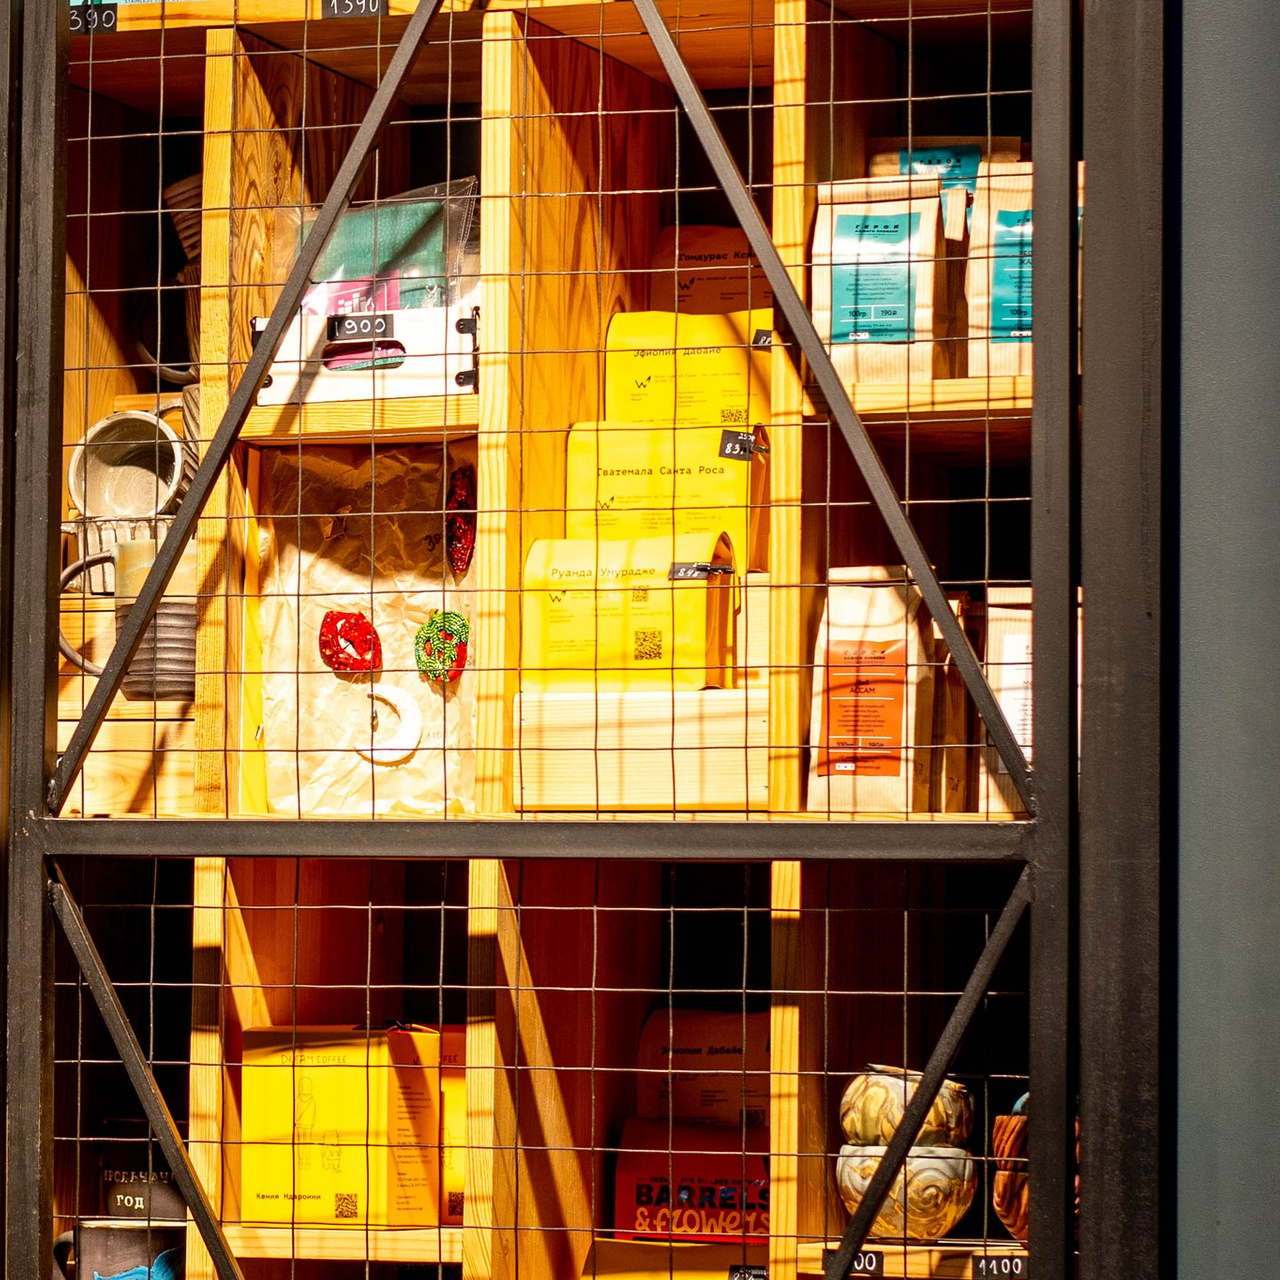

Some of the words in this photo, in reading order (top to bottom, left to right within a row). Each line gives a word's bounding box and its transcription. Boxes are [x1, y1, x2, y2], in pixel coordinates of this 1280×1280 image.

[335, 317, 387, 337] 1900
[597, 467, 653, 477] Гватемала
[699, 465, 725, 475] Роса
[551, 568, 593, 580] Руанда
[600, 567, 656, 580] Умурадже
[116, 1194, 145, 1210] год
[635, 1183, 770, 1211] BARRELS
[978, 1257, 1022, 1275] 1100
